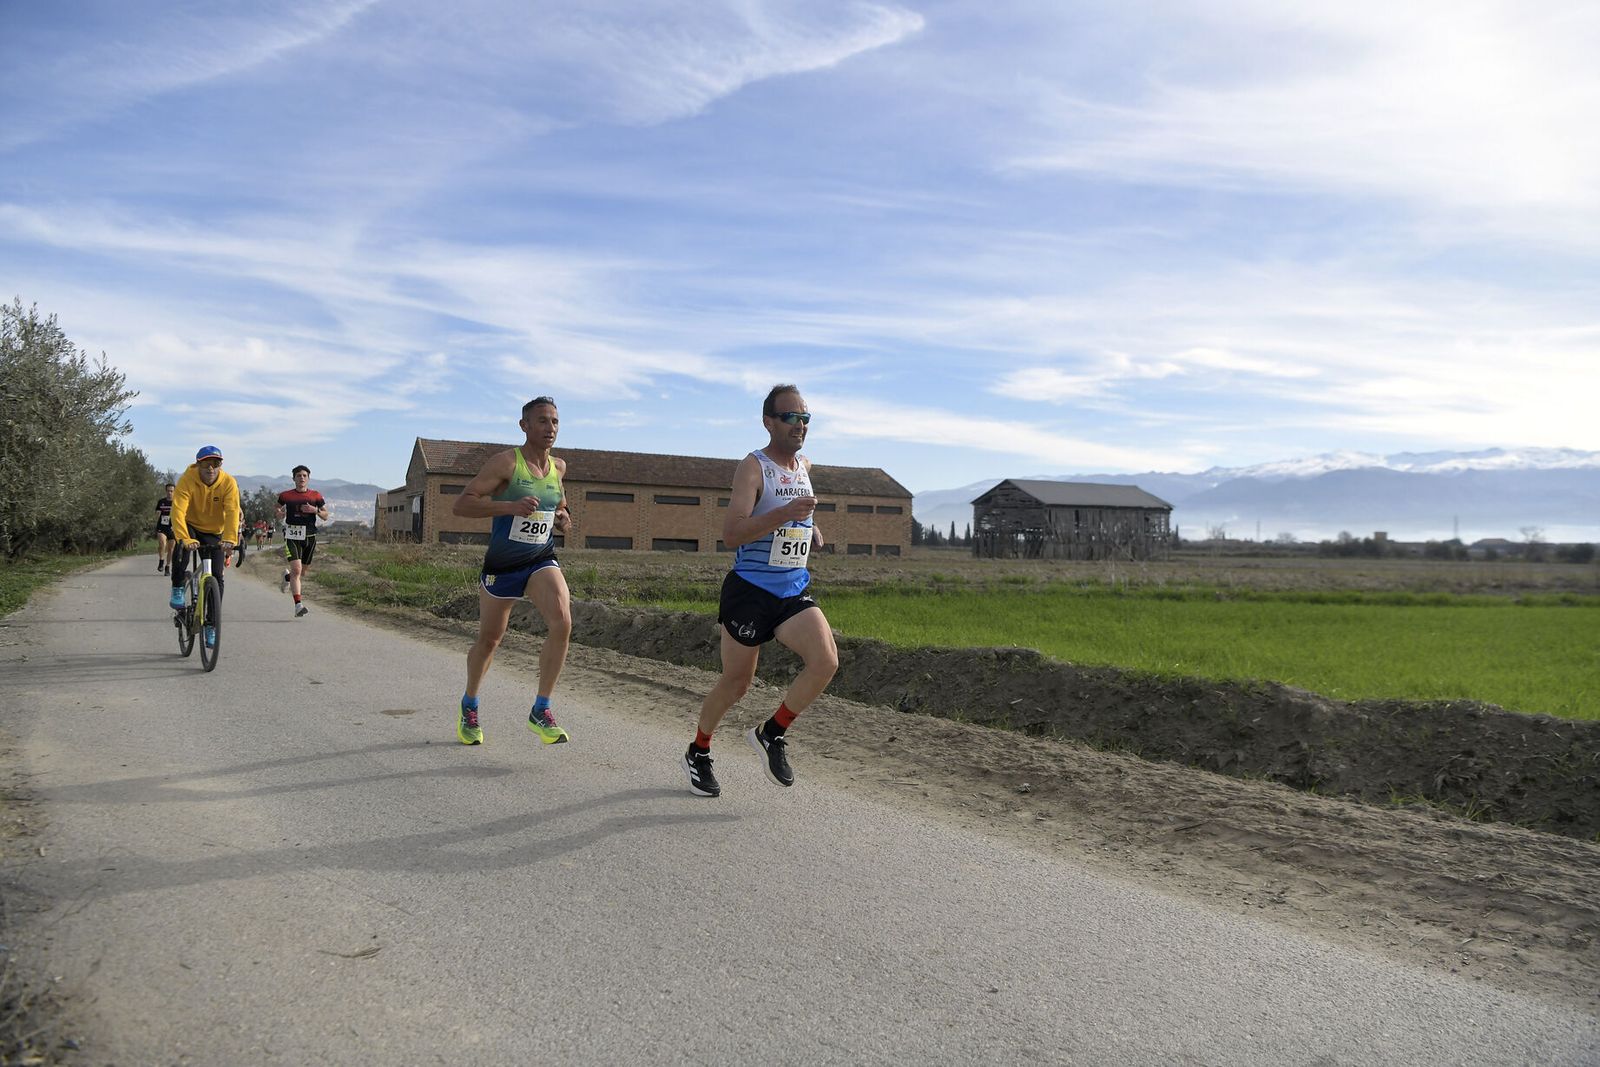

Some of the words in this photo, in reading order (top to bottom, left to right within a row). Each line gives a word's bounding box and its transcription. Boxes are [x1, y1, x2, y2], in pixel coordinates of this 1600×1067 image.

[775, 488, 810, 496] MARACENA
[520, 521, 547, 534] 280
[776, 528, 786, 537] XI
[781, 541, 807, 555] 510
